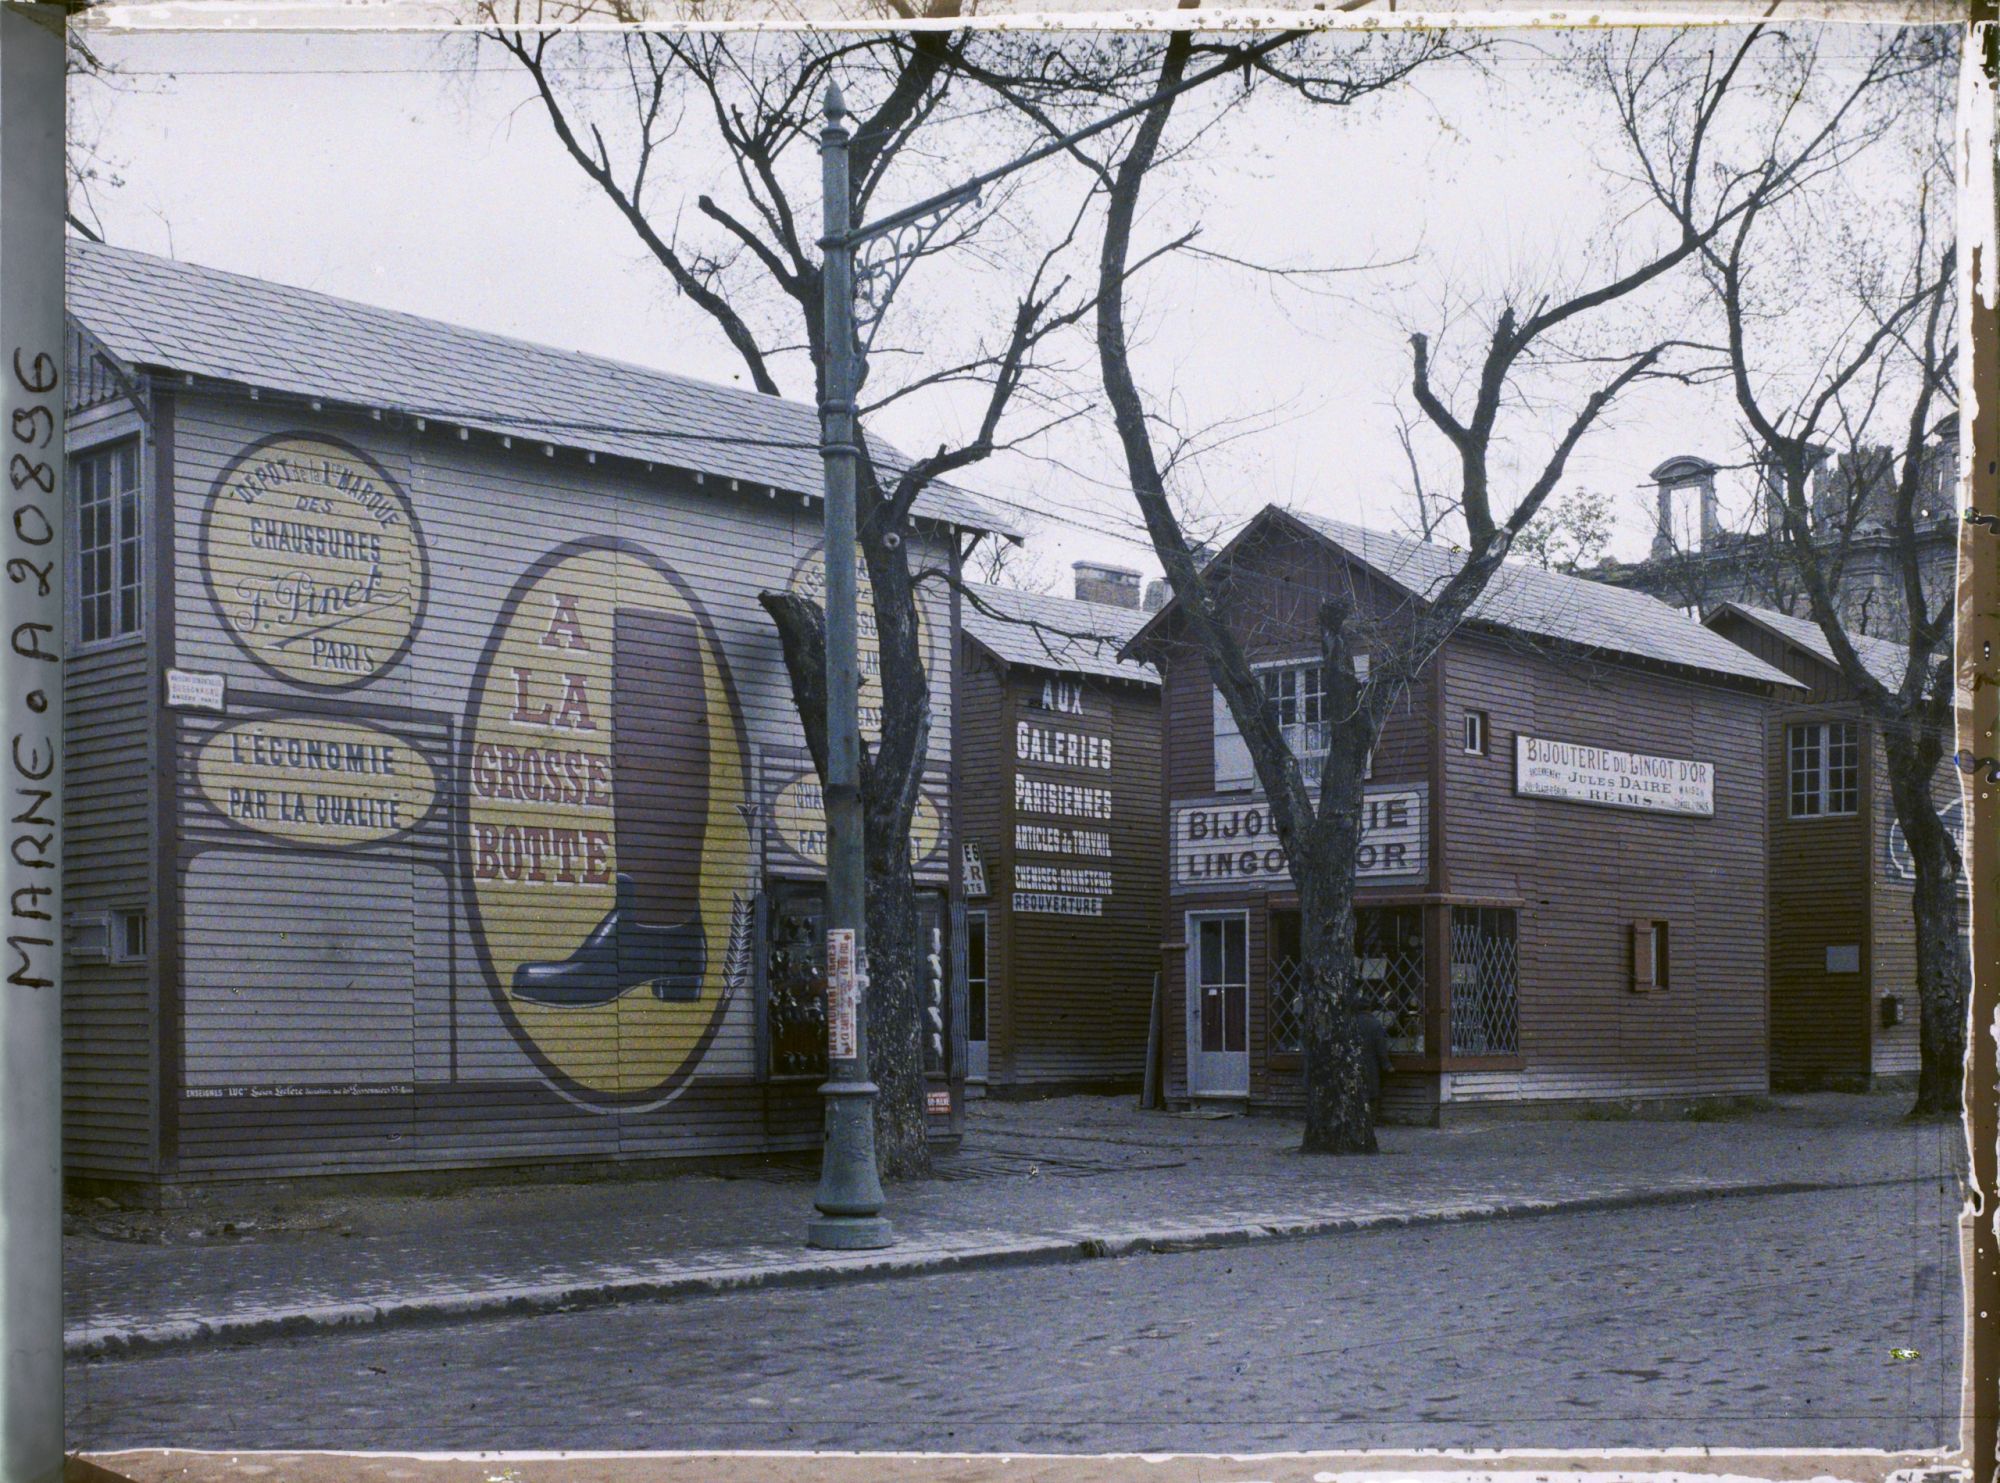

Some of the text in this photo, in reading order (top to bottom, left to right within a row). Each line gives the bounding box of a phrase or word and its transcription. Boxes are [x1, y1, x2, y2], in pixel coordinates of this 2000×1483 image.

[295, 496, 334, 513] DES
[338, 466, 401, 529] MARQUE
[251, 516, 381, 564] CHAUSSURES
[274, 563, 383, 626] Pinet
[538, 592, 592, 653] A
[6, 345, 59, 989] MARNE A 20896
[310, 637, 377, 674] PARIS
[509, 667, 598, 732] LA
[1041, 680, 1084, 715] AUX
[1016, 721, 1112, 769] GALERIES
[1526, 737, 1706, 784] BIJOUTERIE DU LINGOT D'OR
[471, 743, 612, 807] GROSSE
[1015, 773, 1112, 819] PARISIENNES
[1568, 772, 1616, 787] JULES
[1620, 776, 1672, 794] DAIRE
[1589, 789, 1652, 806] REIMS
[228, 788, 401, 830] PAR LA QUALITÉ
[473, 822, 612, 887] BOTTE
[1015, 825, 1060, 852] ARTICLES
[1072, 830, 1113, 857] TRAVAIL
